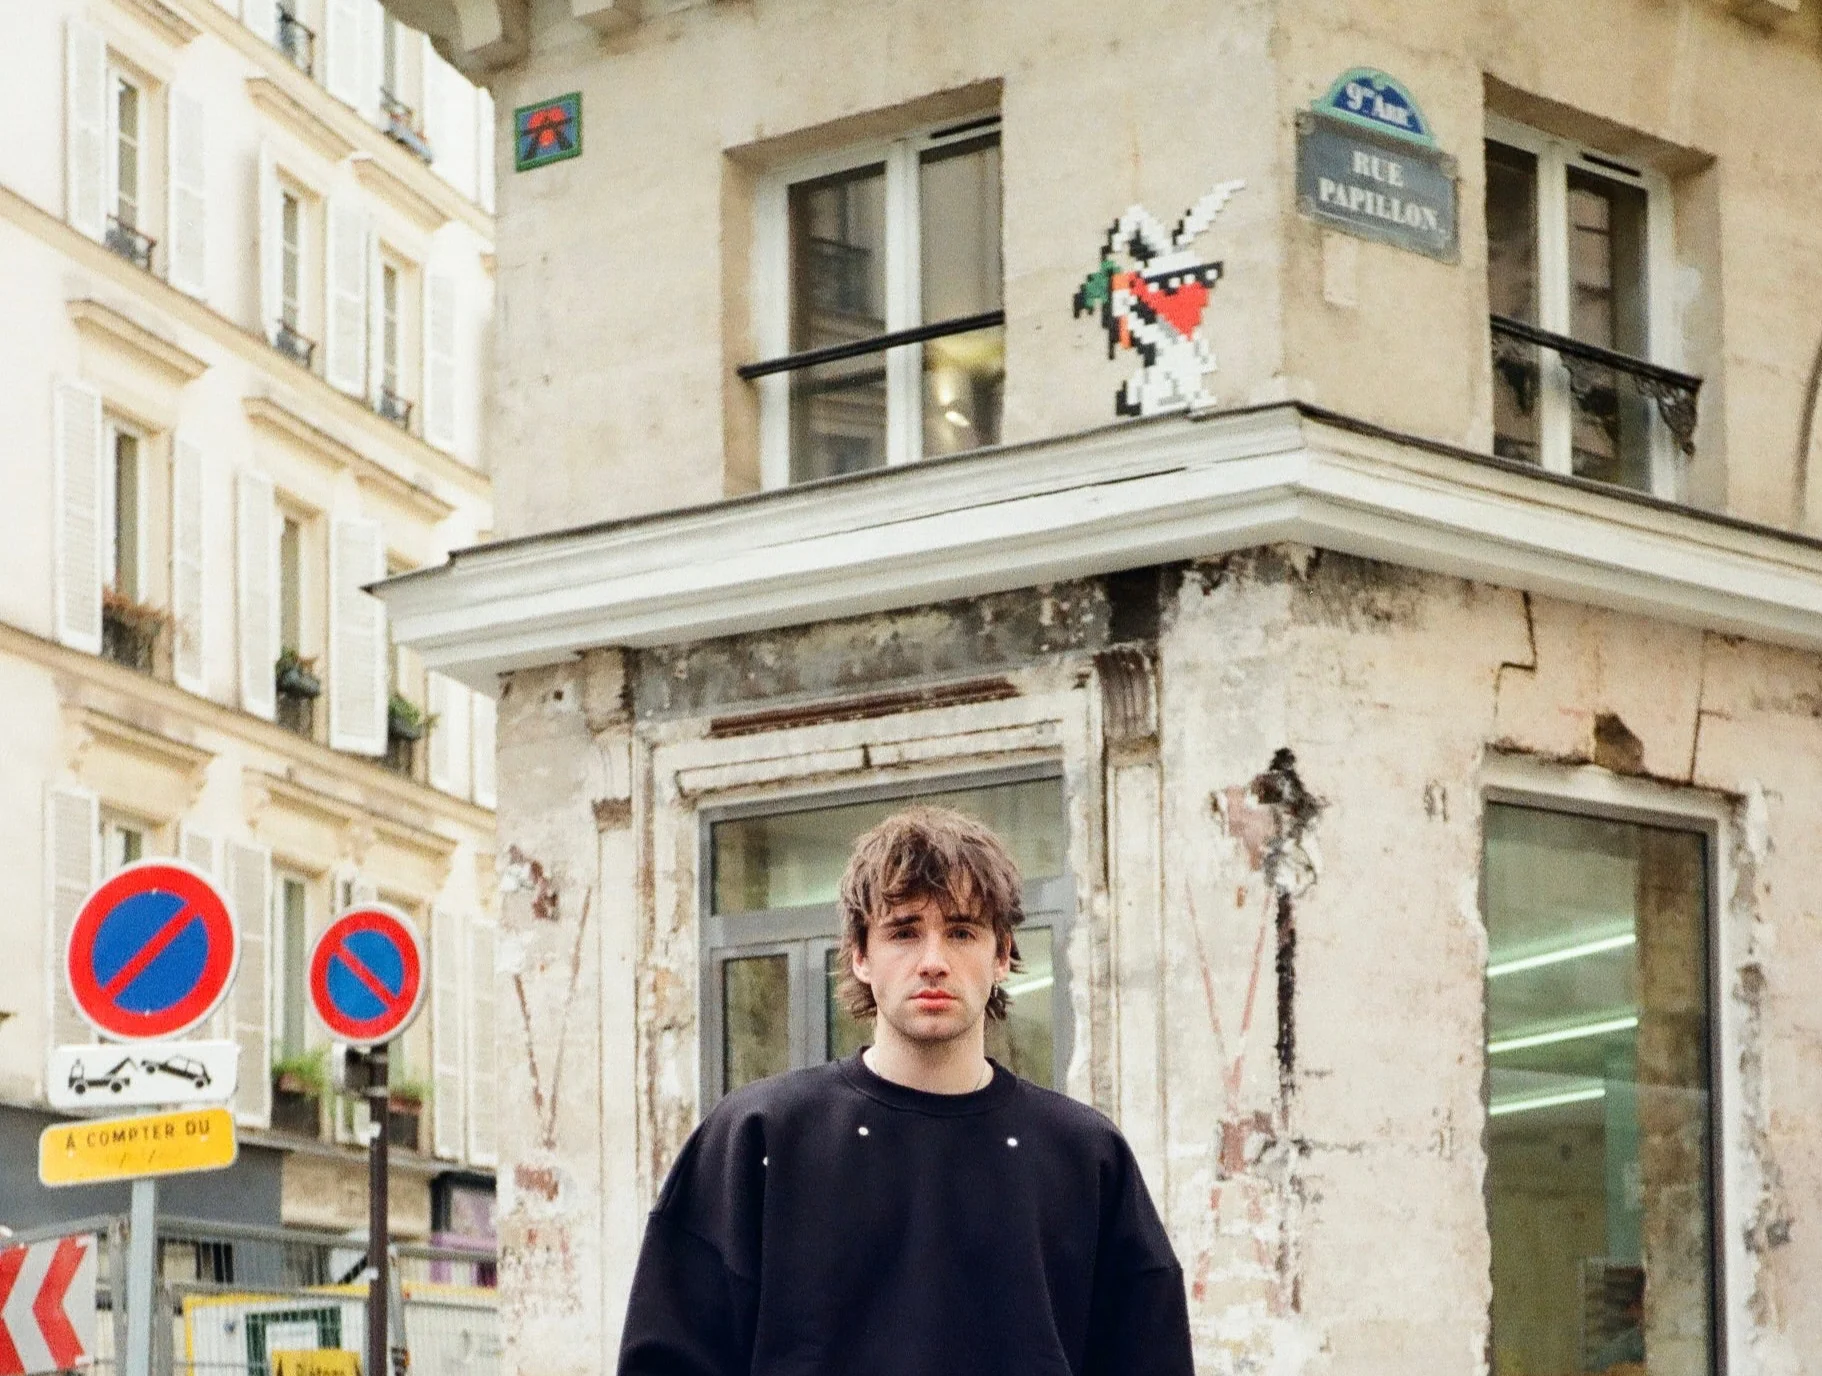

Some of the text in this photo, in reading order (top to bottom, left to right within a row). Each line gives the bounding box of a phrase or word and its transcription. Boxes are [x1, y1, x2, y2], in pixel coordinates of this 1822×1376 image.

[1352, 151, 1404, 187] RUE
[1319, 177, 1438, 230] PAPILLON
[87, 1122, 174, 1148] COMPTER
[185, 1119, 210, 1137] DU
